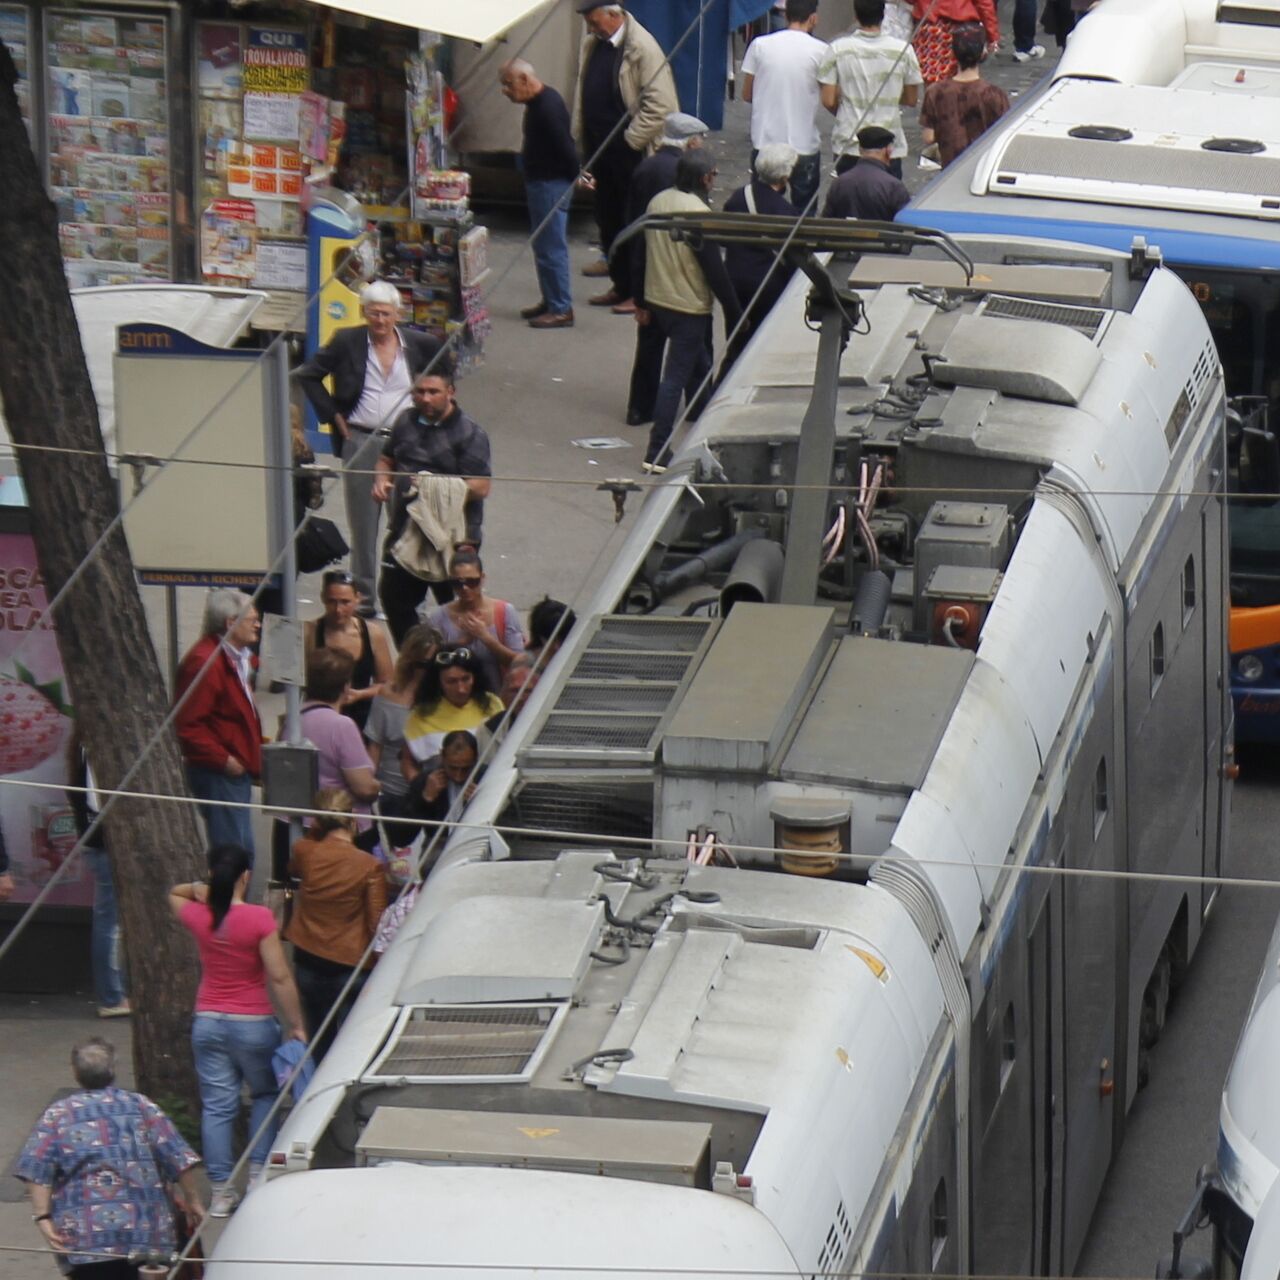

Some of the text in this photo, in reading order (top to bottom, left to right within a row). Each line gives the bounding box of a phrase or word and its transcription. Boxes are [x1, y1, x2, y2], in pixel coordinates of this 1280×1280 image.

[260, 31, 294, 45] QUI
[243, 48, 306, 67] TROVALAVORO
[119, 331, 172, 347] anm
[143, 573, 196, 583] FERMATA
